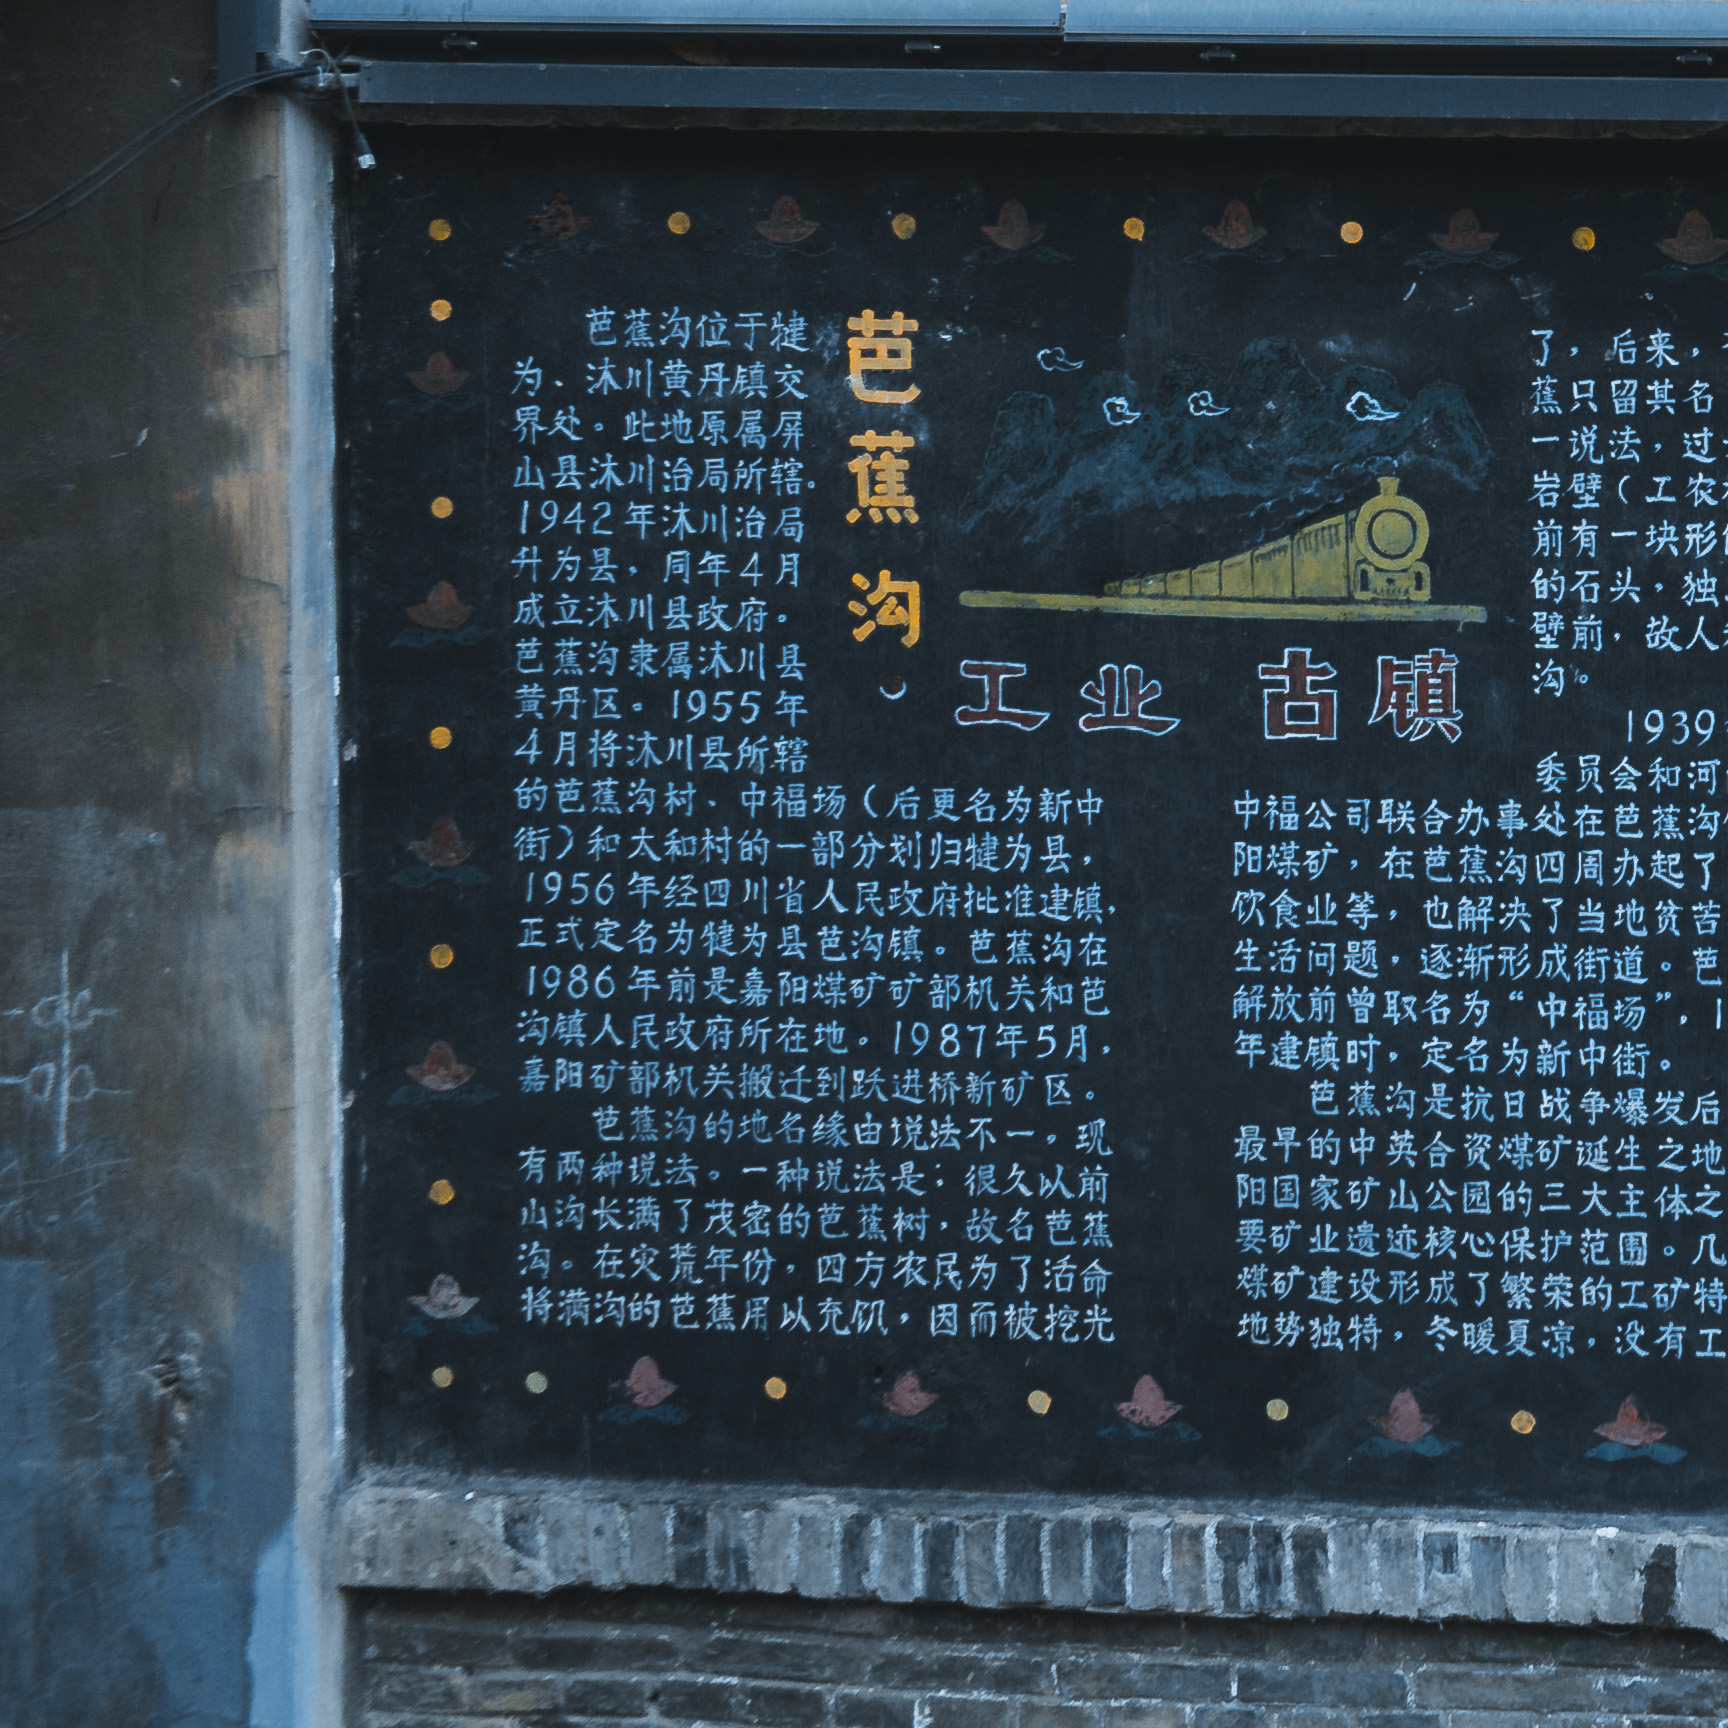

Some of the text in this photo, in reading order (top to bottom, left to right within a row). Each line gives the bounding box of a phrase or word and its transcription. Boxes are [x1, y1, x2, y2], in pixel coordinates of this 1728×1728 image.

[585, 306, 809, 352] 芭蕉沟位于犍
[845, 308, 922, 648] 芭蕉沟
[520, 500, 804, 543] 1942年沐川治局
[516, 637, 806, 681] 芭蕉沟隶属沐川县
[1532, 658, 1588, 697] 沟。
[955, 647, 1463, 742] 工业 古镇
[514, 728, 808, 774] 4月将沐川县所辖
